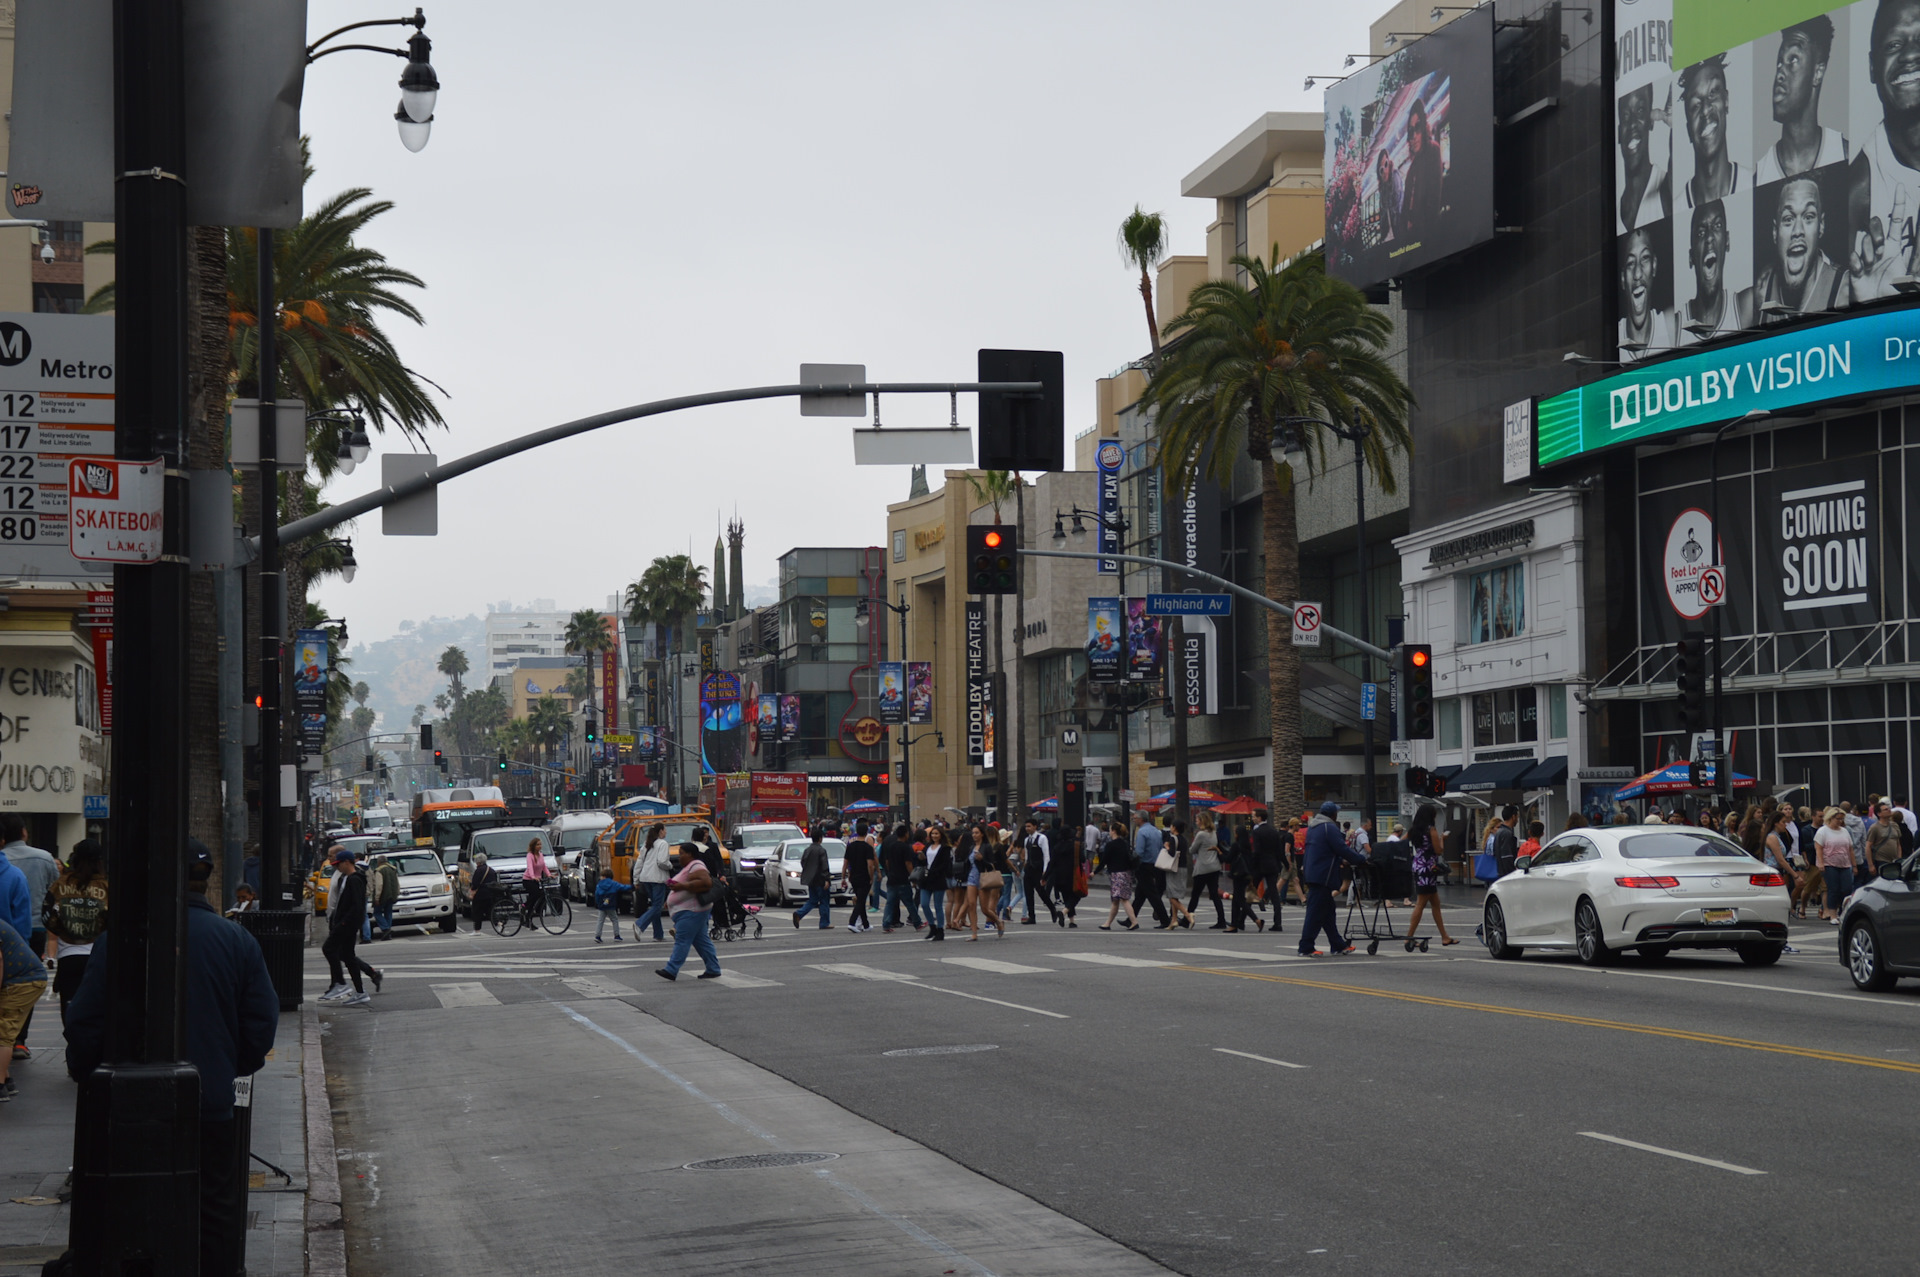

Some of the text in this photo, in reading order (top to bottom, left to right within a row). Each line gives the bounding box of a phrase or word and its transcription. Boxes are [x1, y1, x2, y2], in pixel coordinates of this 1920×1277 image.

[41, 359, 113, 379] Metro
[1645, 365, 1741, 418] DOLBY
[1746, 340, 1851, 393] VISION
[41, 400, 75, 408] Hollywood
[40, 432, 90, 440] Hollywood/Vine
[1104, 474, 1117, 499] PLAY
[1782, 496, 1866, 540] COMING
[1671, 565, 1687, 579] Foot
[1783, 537, 1867, 596] SOON
[1153, 598, 1223, 613] Highland Av
[1295, 633, 1303, 641] ON
[969, 611, 982, 732] DOLBY THEATRE
[1184, 638, 1200, 705] essentia
[1367, 685, 1375, 717] SYNC
[1477, 707, 1537, 728] LIVE YOUR LIFE
[1434, 778, 1446, 793] 21
[85, 797, 107, 808] ATM
[436, 810, 450, 820] 217
